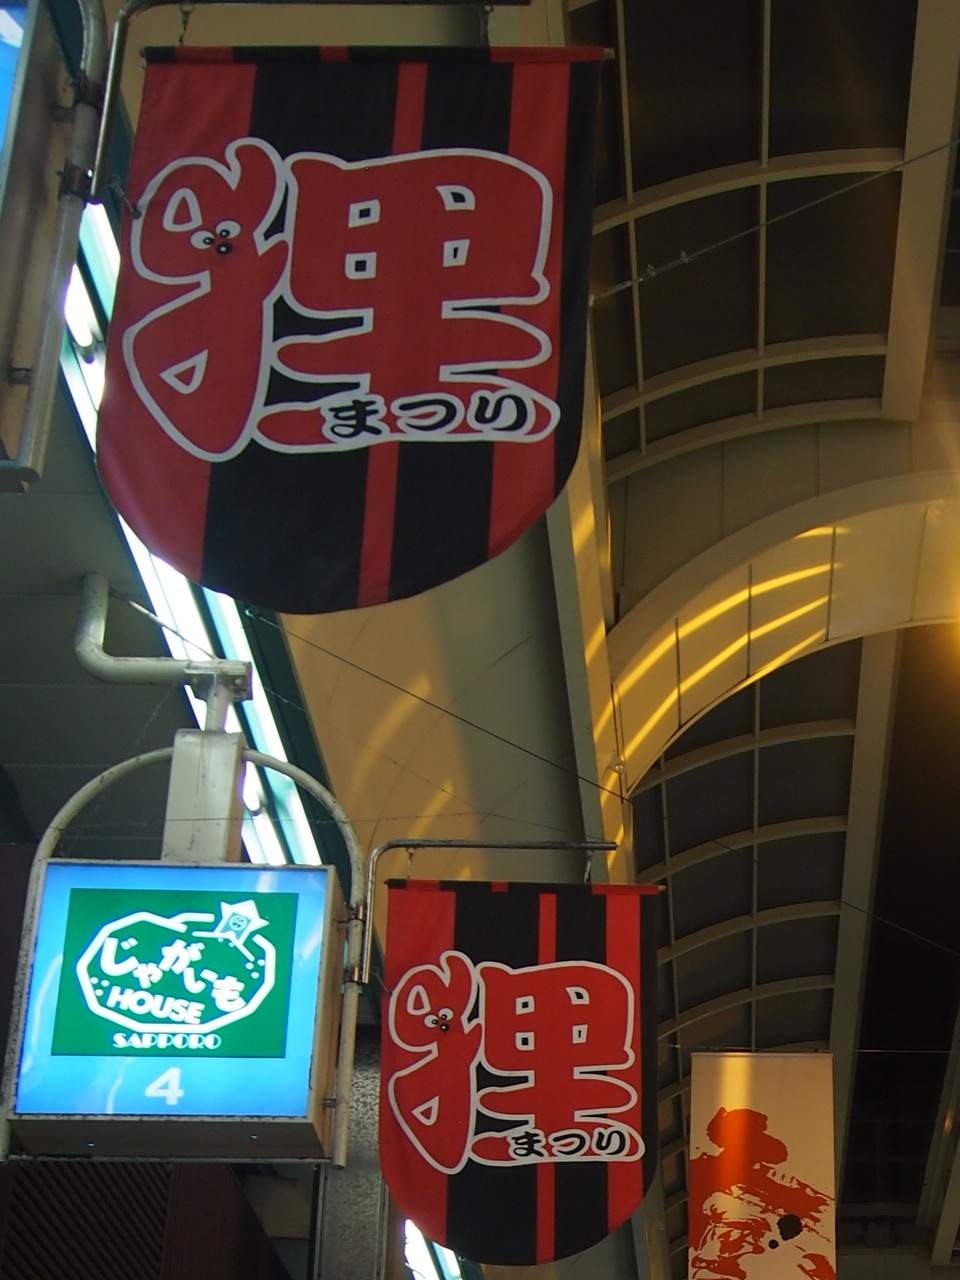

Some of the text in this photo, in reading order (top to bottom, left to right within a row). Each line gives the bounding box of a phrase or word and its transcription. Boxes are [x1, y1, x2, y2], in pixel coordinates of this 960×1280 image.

[328, 391, 530, 440] まつり
[101, 938, 247, 1013] じゃがいも
[106, 986, 206, 1025] HOUSE
[112, 1032, 222, 1050] SAPPORO
[144, 1066, 185, 1106] 4
[510, 1128, 628, 1157] まつり
